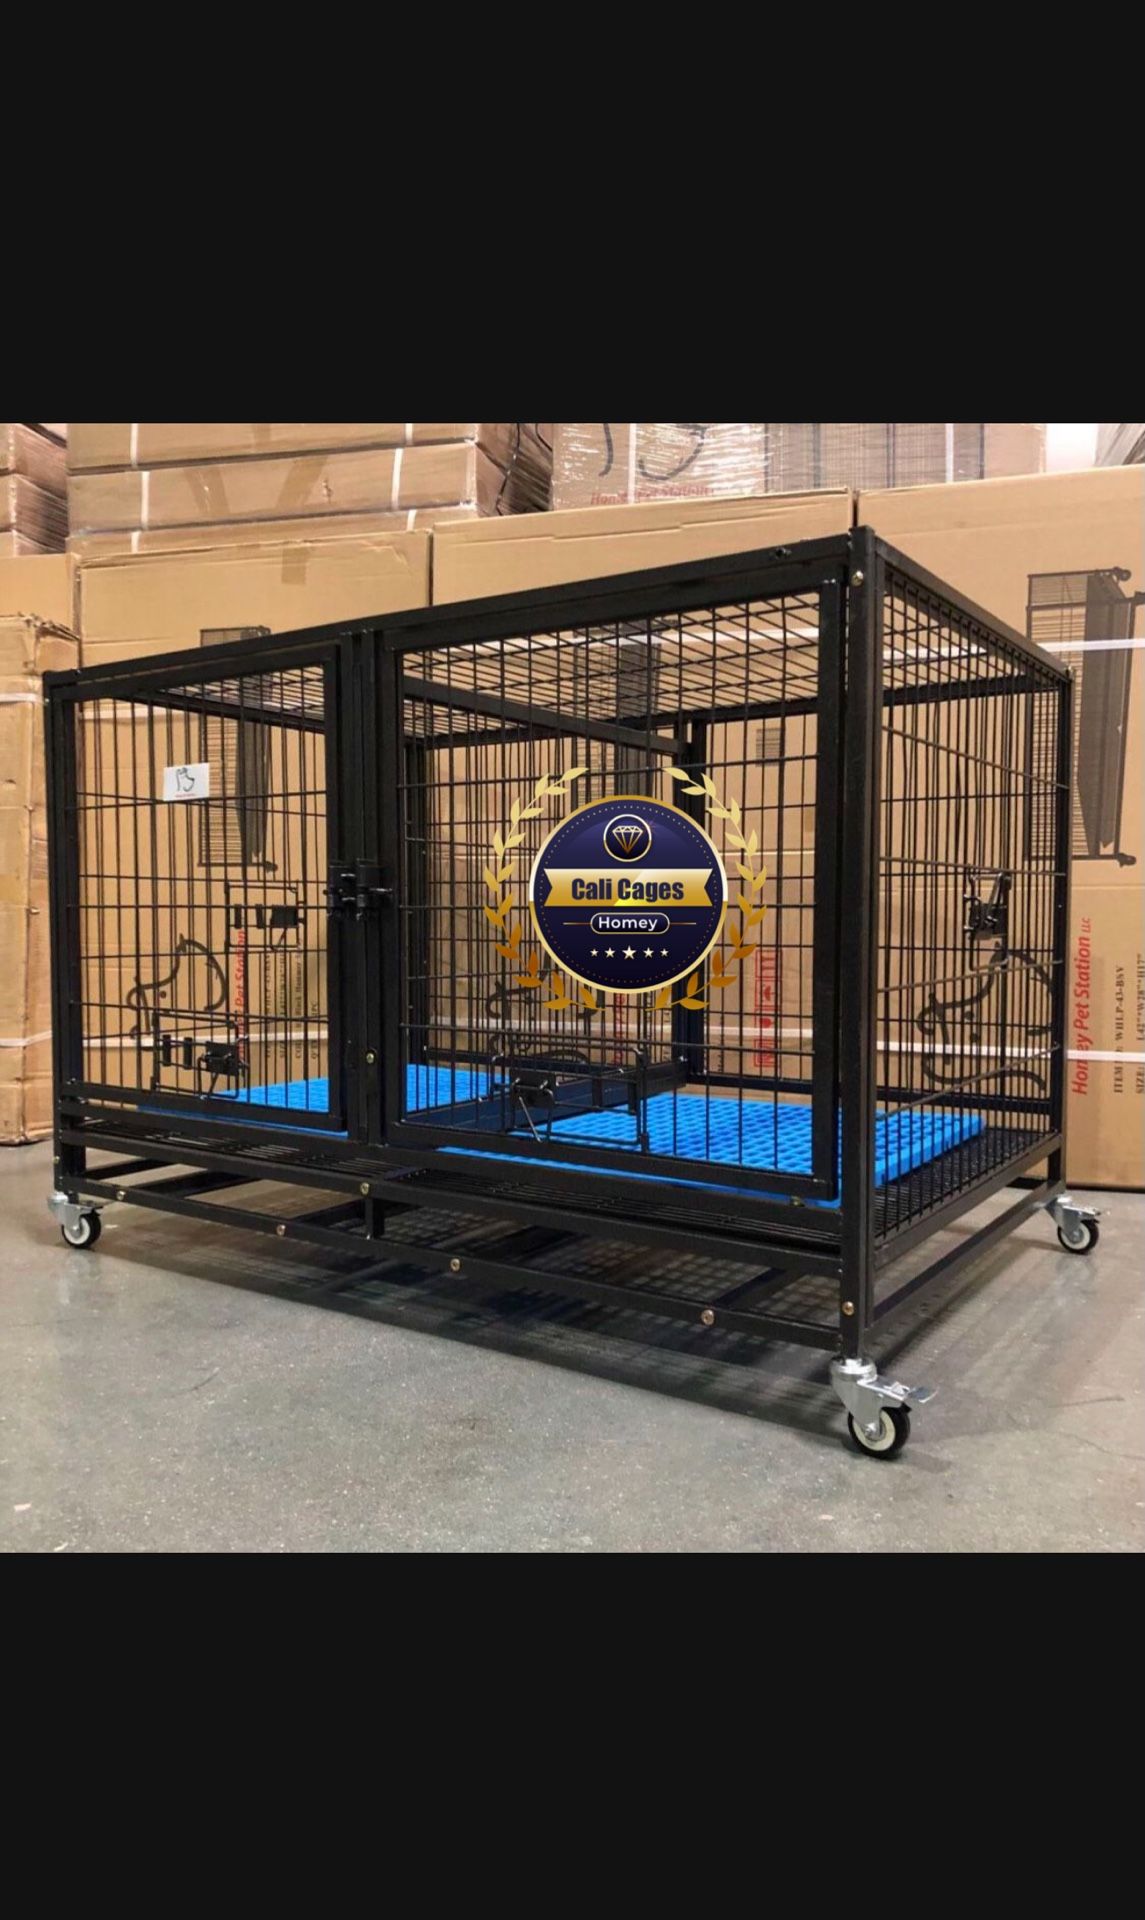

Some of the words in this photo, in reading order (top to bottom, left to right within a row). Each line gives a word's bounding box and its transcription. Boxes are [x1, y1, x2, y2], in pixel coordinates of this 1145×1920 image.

[1082, 917, 1092, 933] LLC
[1073, 936, 1091, 999] Station
[1073, 1003, 1090, 1031] Pet
